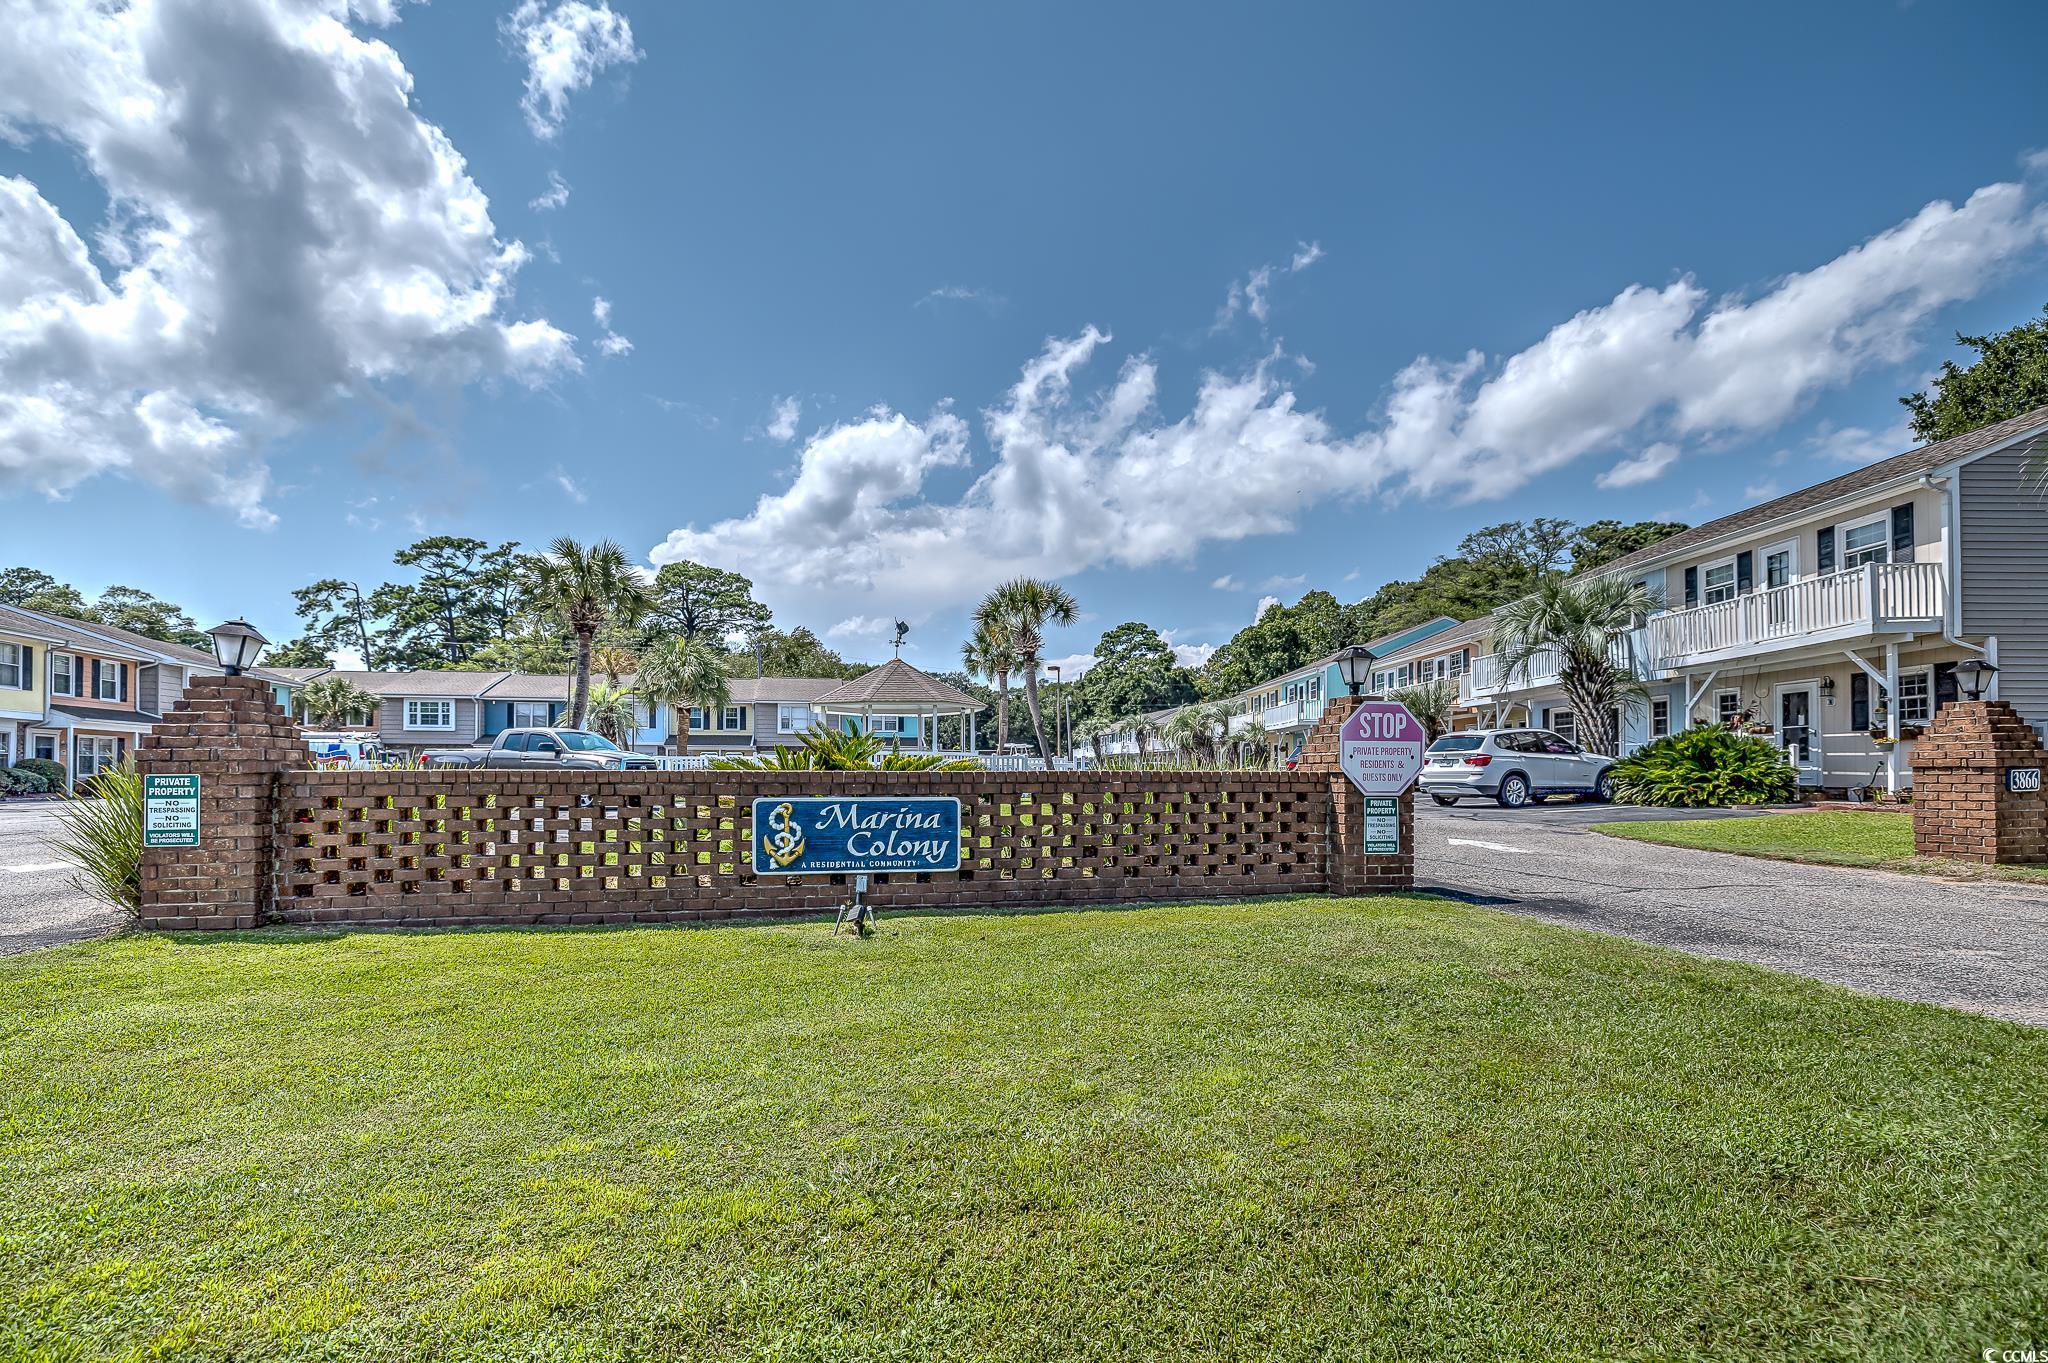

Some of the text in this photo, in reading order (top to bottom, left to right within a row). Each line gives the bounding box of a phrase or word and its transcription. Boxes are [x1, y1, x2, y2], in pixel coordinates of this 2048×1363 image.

[1359, 712, 1407, 739] STOP
[1352, 746, 1413, 756] PRIVATE PROPERTY
[1360, 760, 1405, 769] RESIDENTS &
[154, 777, 191, 786] PRIVATE
[1362, 773, 1403, 782] GUESTS ONLY
[2013, 771, 2038, 789] 3866
[148, 787, 196, 796] PROPERTY
[1366, 807, 1396, 815] PROPERTY
[815, 804, 942, 830] Marina
[847, 830, 950, 863] Colony
[801, 861, 807, 869] A
[810, 860, 866, 869] RESIDENTIAL
